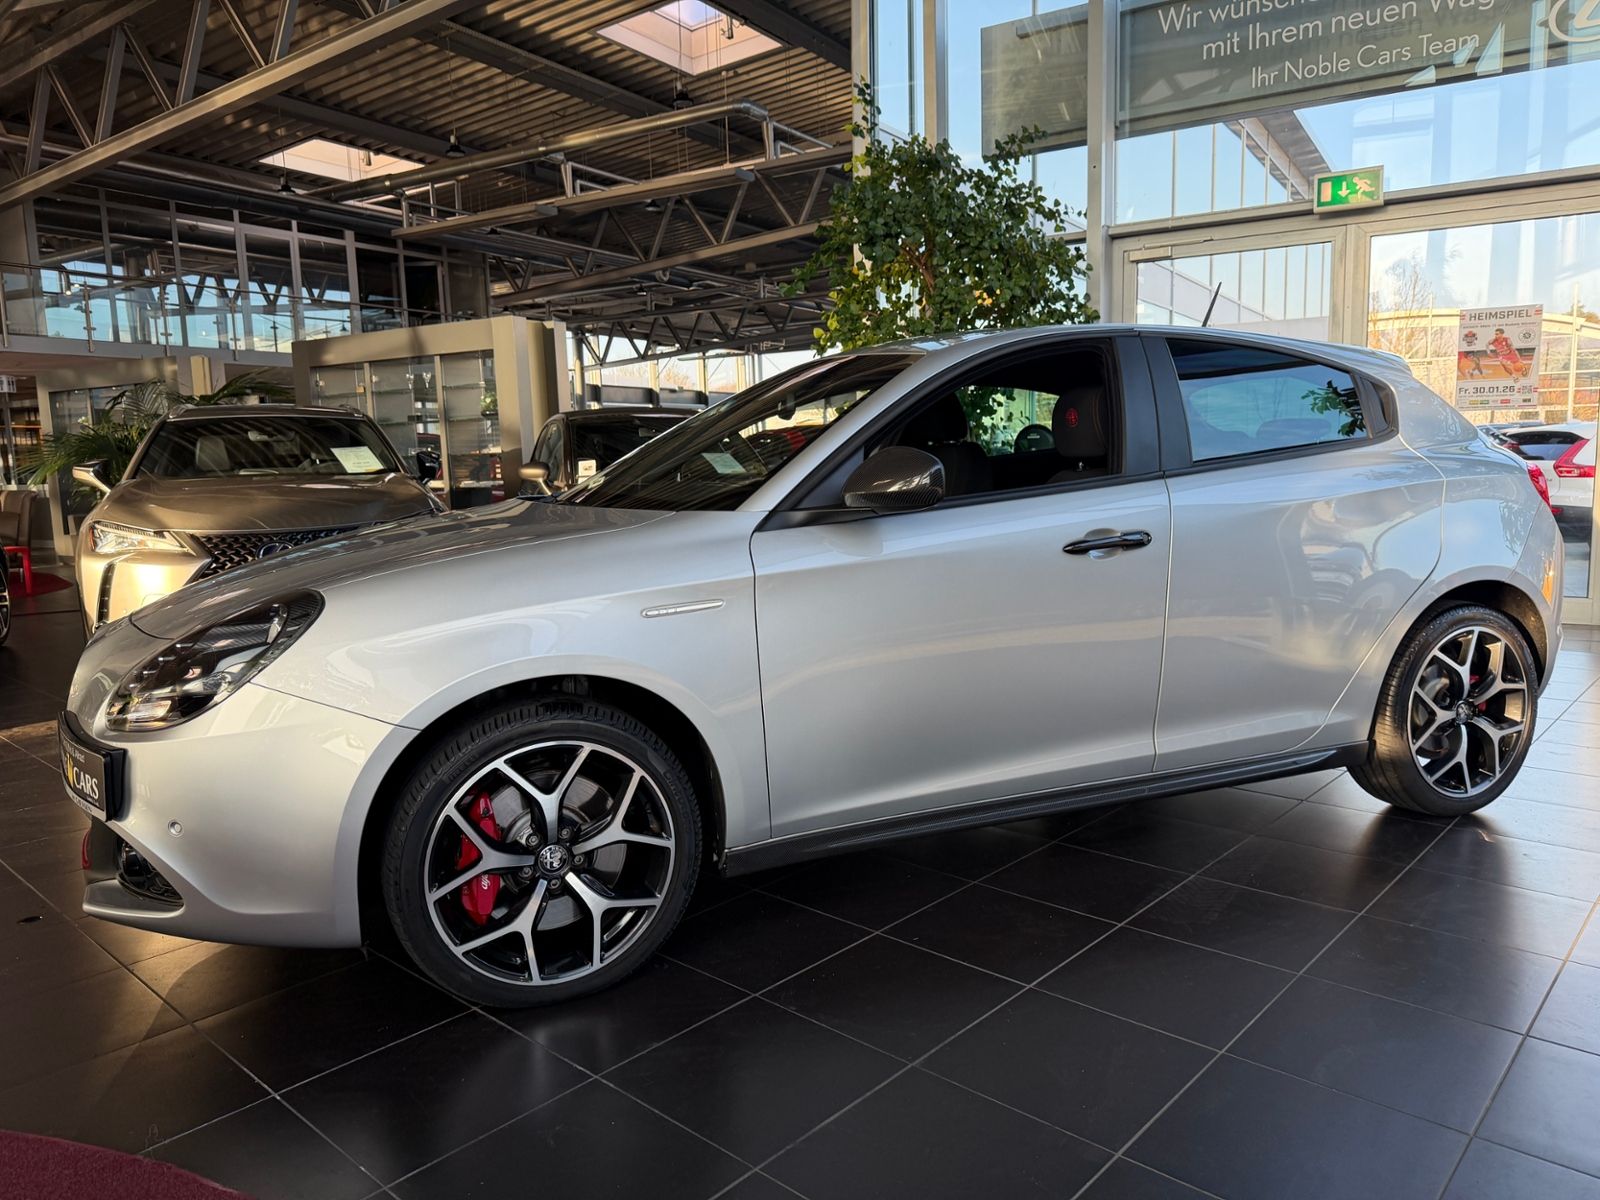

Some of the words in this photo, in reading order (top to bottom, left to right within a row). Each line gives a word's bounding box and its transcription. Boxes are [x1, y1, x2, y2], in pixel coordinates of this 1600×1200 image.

[1158, 4, 1202, 34] Wir
[1203, 32, 1240, 60] mit
[1249, 22, 1322, 50] Ihrem
[1331, 1, 1416, 33] neuen
[1252, 66, 1278, 88] Ihr
[1284, 51, 1350, 82] Noble
[1357, 44, 1411, 68] Cars
[1418, 33, 1480, 57] Team
[1469, 310, 1532, 320] HEIMSPIEL
[1472, 386, 1516, 394] 30.01.26
[74, 767, 98, 799] CARS
